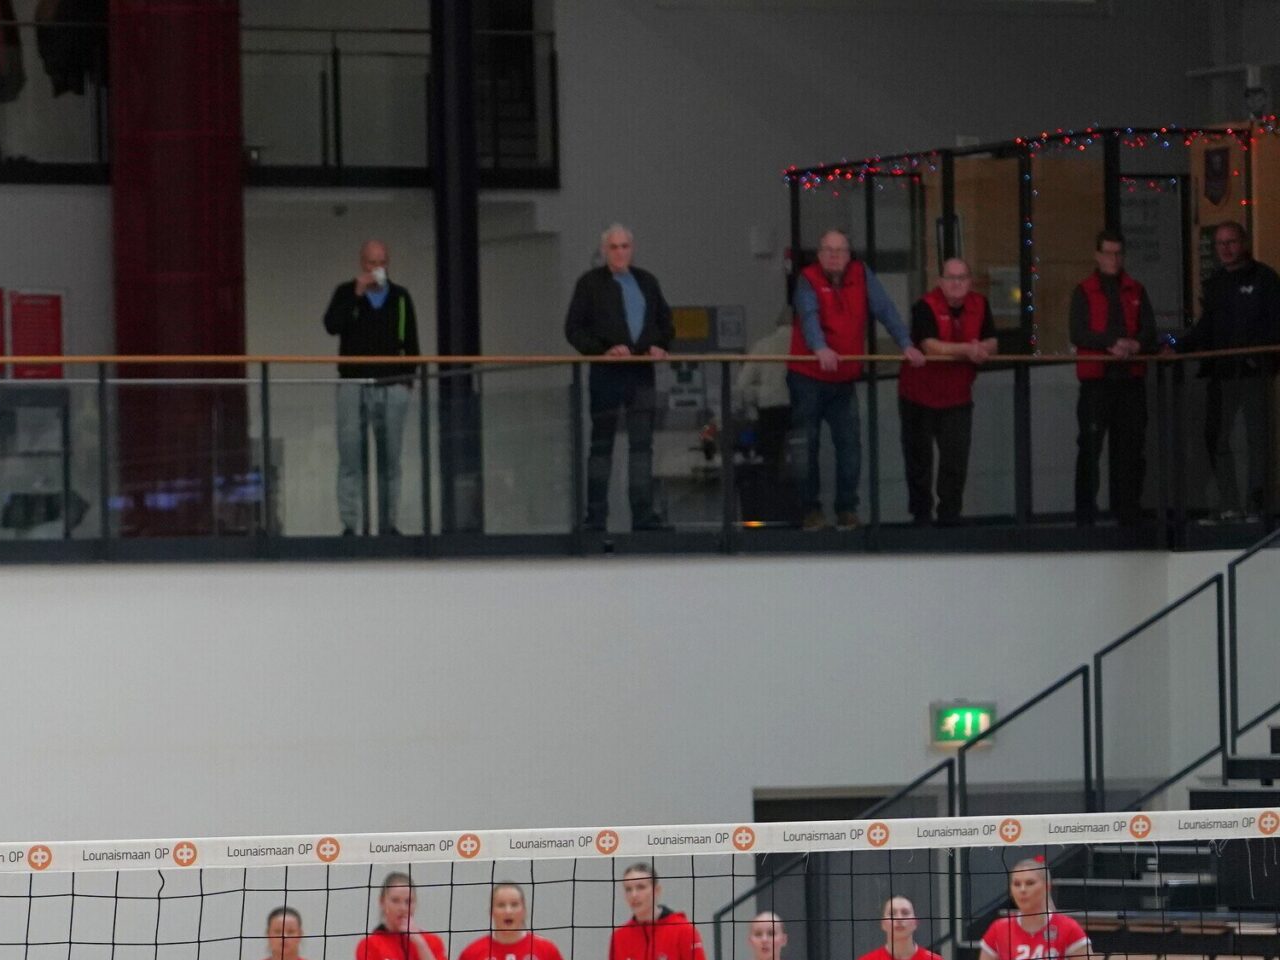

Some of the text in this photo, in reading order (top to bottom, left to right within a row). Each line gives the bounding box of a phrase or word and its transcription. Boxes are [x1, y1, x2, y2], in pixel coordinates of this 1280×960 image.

[1048, 820, 1126, 834] Lounaismaan OP
[1178, 817, 1255, 831] Lounaismaan OP
[783, 829, 863, 843] Lounaismaan OP
[917, 824, 996, 839] Lounaismaan OP
[369, 839, 453, 854] Lounaismaan OP
[509, 836, 592, 850] Lounaismaan OP
[647, 833, 729, 847] Lounaismaan OP
[9, 851, 24, 863] OP
[82, 848, 169, 862] Lounaismaan OP
[227, 844, 312, 859] Lounaismaan OP
